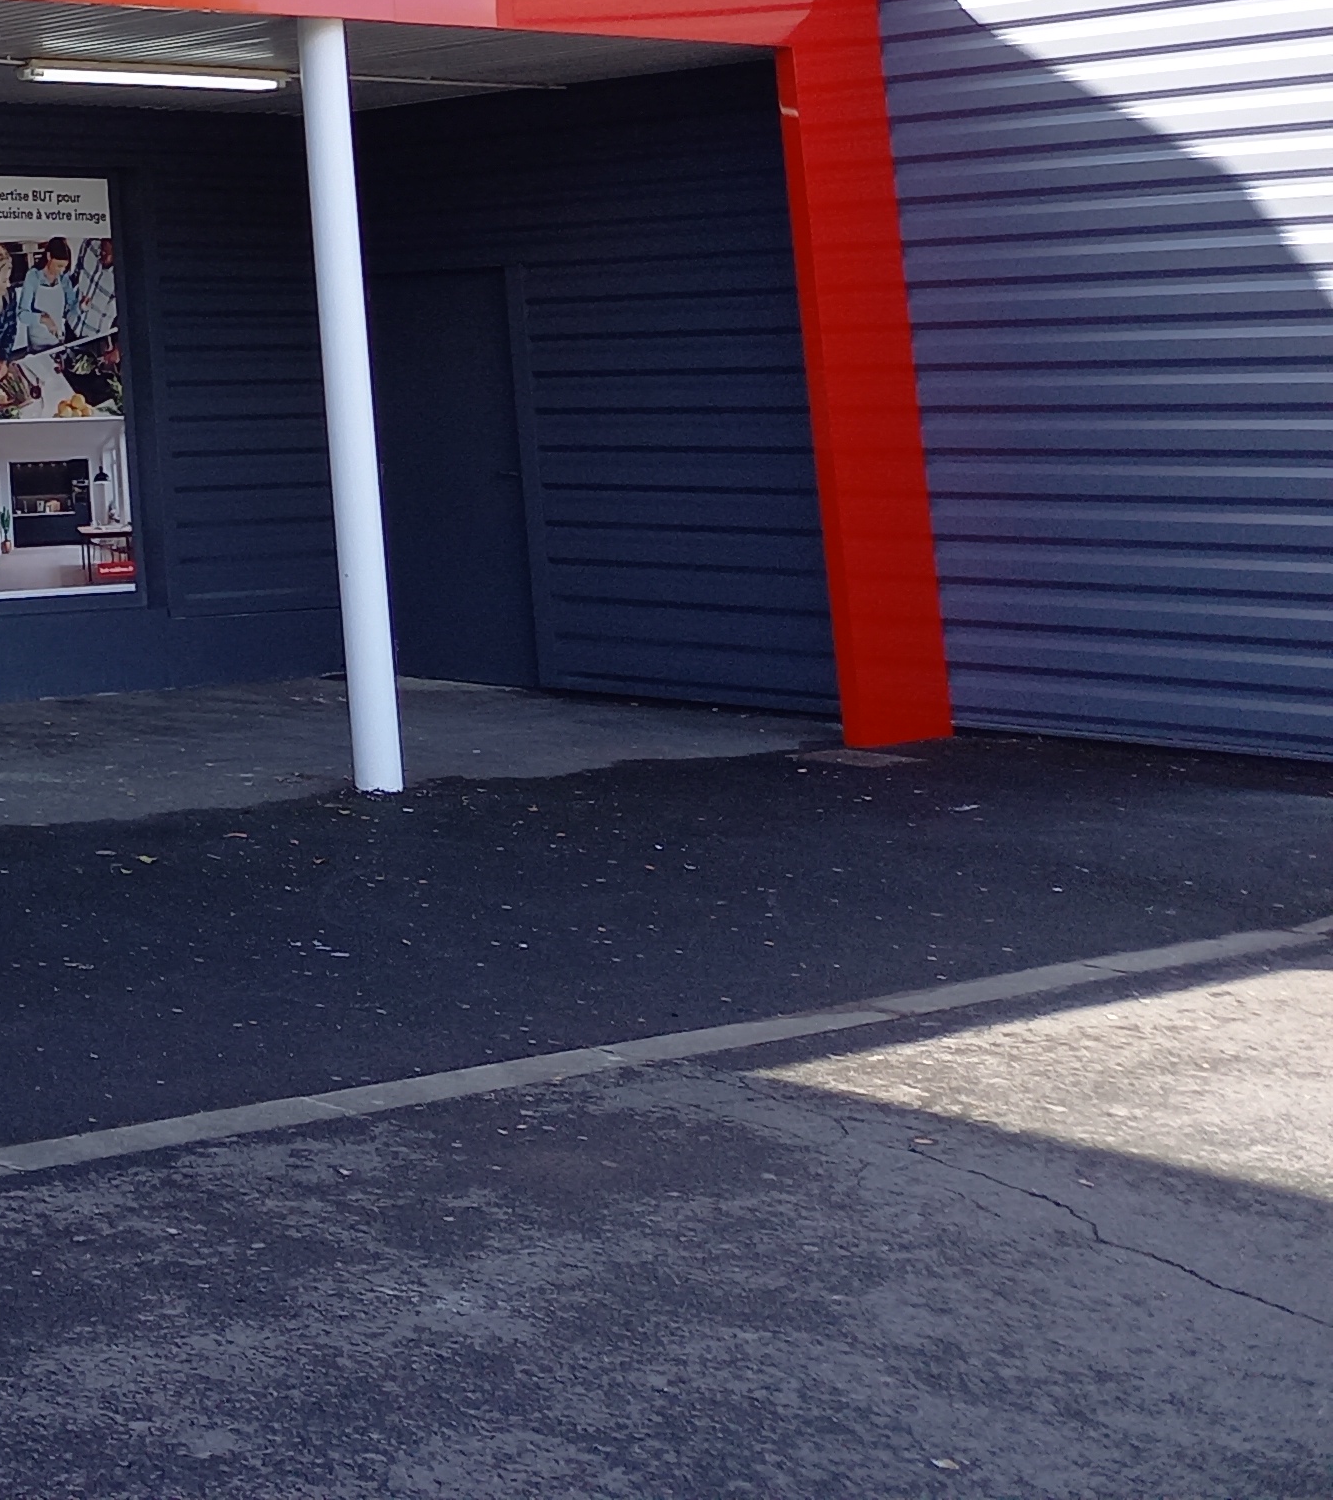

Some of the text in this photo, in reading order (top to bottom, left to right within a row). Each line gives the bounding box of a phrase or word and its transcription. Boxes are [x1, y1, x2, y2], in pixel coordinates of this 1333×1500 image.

[32, 189, 54, 203] BUT
[56, 193, 82, 206] pour
[36, 208, 42, 221] à
[44, 210, 72, 222] votre
[74, 208, 107, 224] image
